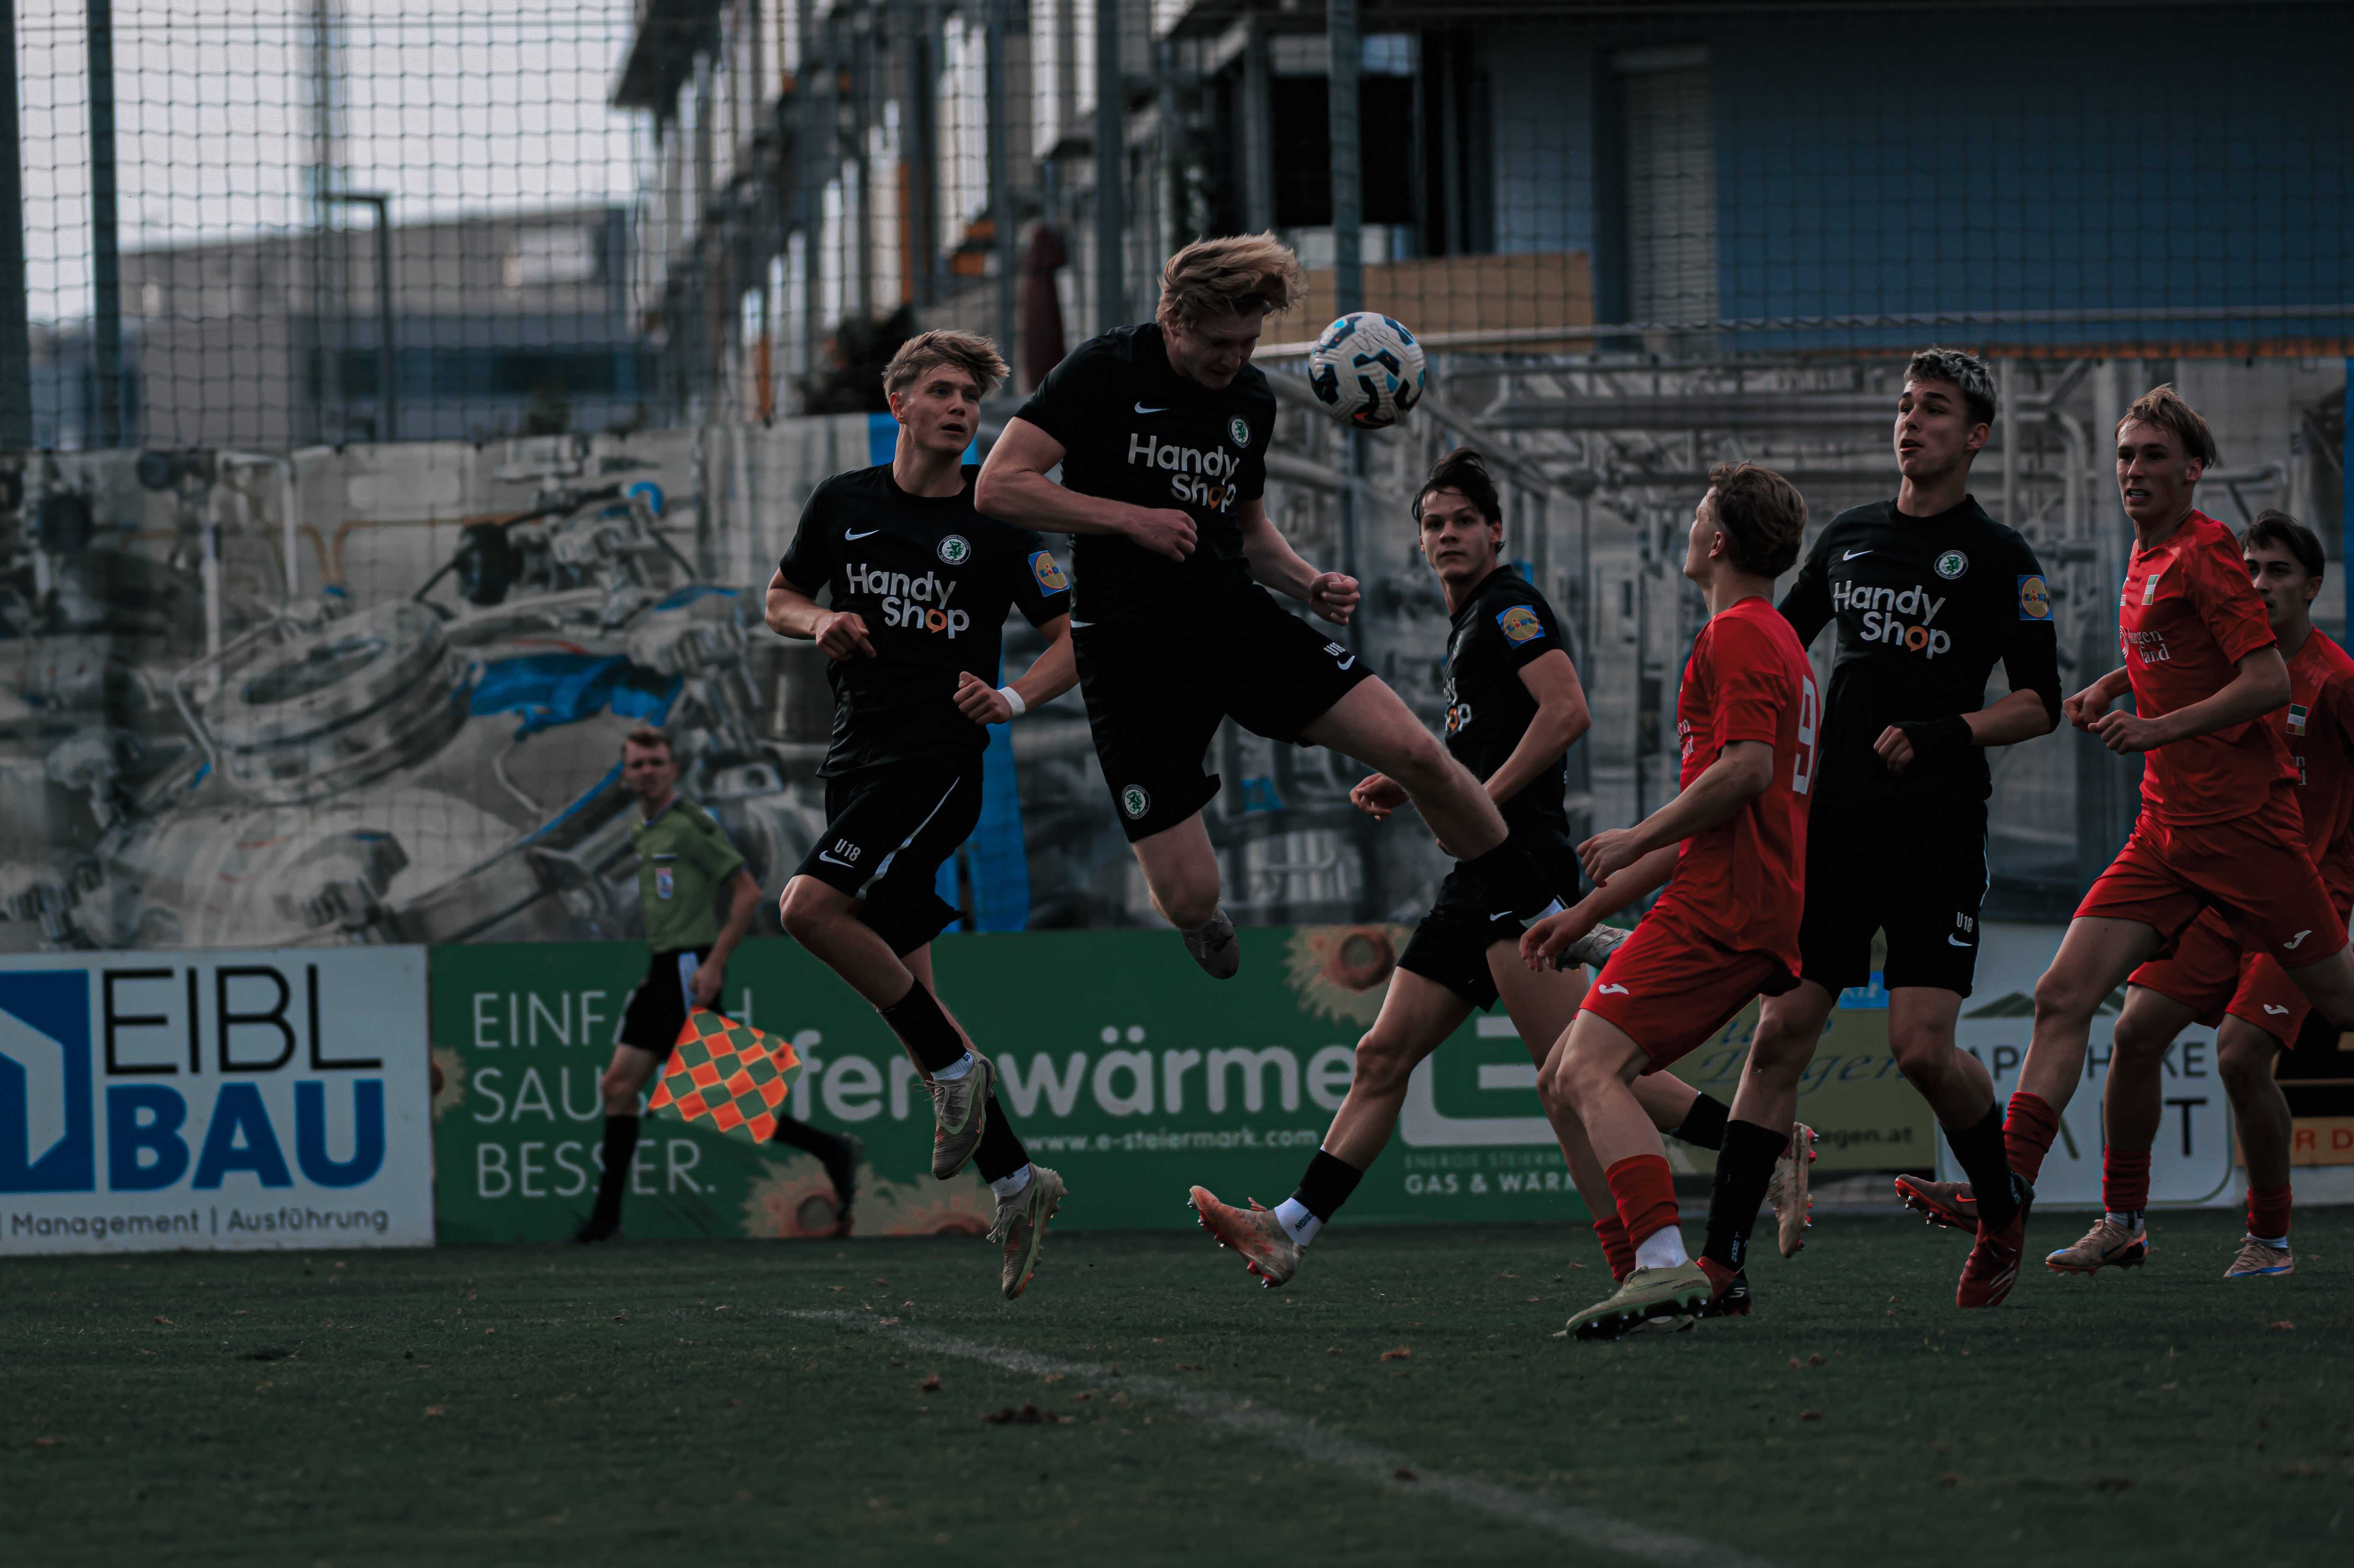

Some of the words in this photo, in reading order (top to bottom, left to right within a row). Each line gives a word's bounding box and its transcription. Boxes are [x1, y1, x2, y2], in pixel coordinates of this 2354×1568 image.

[1128, 433, 1240, 485] Handy
[1171, 473, 1236, 512] Shop
[846, 564, 956, 609] Handy
[1834, 580, 1946, 625] Handy
[882, 596, 969, 639] Shop
[1860, 612, 1951, 659] Shop
[2127, 627, 2163, 648] burgen
[1324, 642, 1346, 656] U18
[2139, 643, 2171, 663] land
[1793, 674, 1816, 795] 9
[834, 838, 860, 861] U18
[1956, 912, 1973, 932] U18
[103, 963, 382, 1075] EIBL
[473, 988, 752, 1047] EINF
[790, 1024, 1357, 1122] ferwärme
[106, 1079, 385, 1192] BAU
[1488, 1150, 1569, 1167] STEIERM
[1404, 1173, 1459, 1194] GAS
[1469, 1172, 1488, 1194] &
[1498, 1170, 1579, 1192] WÄRM
[11, 1209, 199, 1238] Management
[227, 1207, 389, 1232] Ausführung
